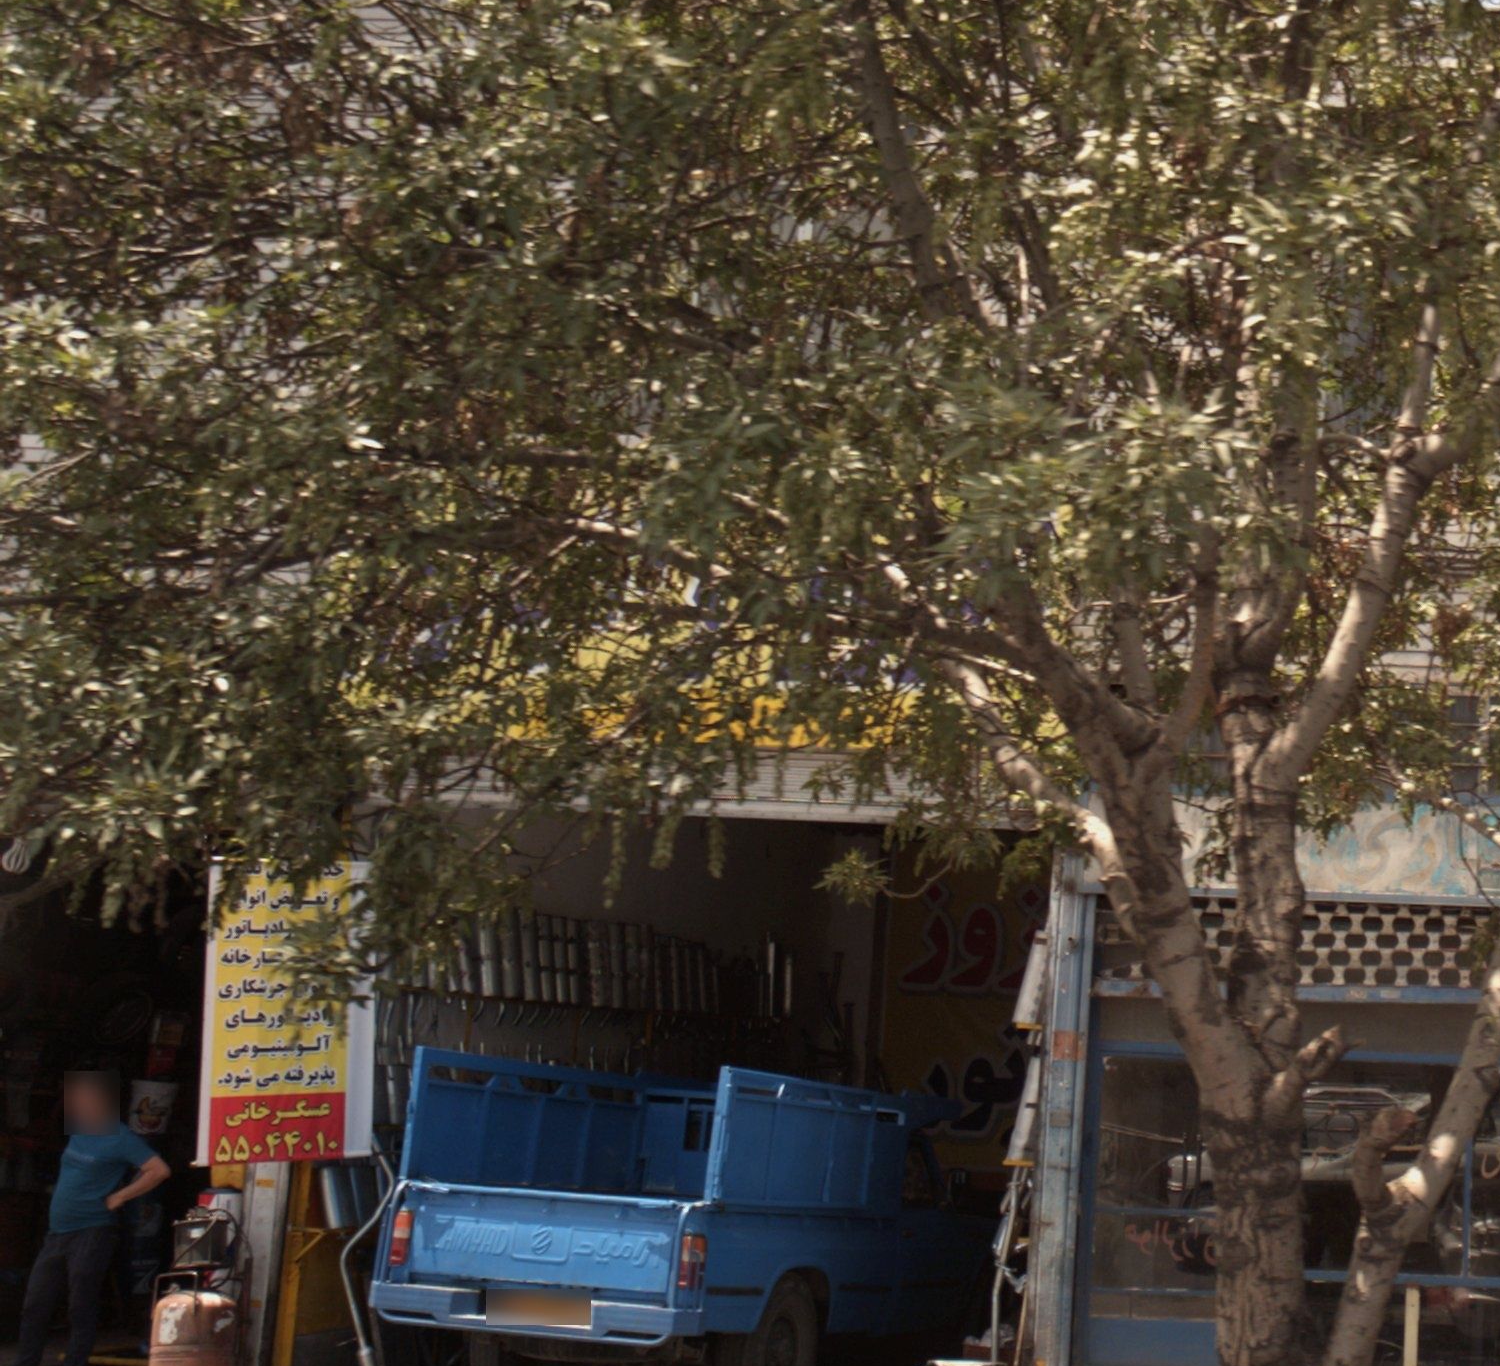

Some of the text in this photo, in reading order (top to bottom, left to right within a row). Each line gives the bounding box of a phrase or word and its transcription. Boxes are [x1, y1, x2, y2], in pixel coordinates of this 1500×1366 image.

[225, 1006, 335, 1028] رادیورهای
[256, 1073, 280, 1088] می
[284, 1064, 336, 1086] پذیرفته
[215, 1130, 339, 1163] ۵۵۰۴۴۰۱۰
